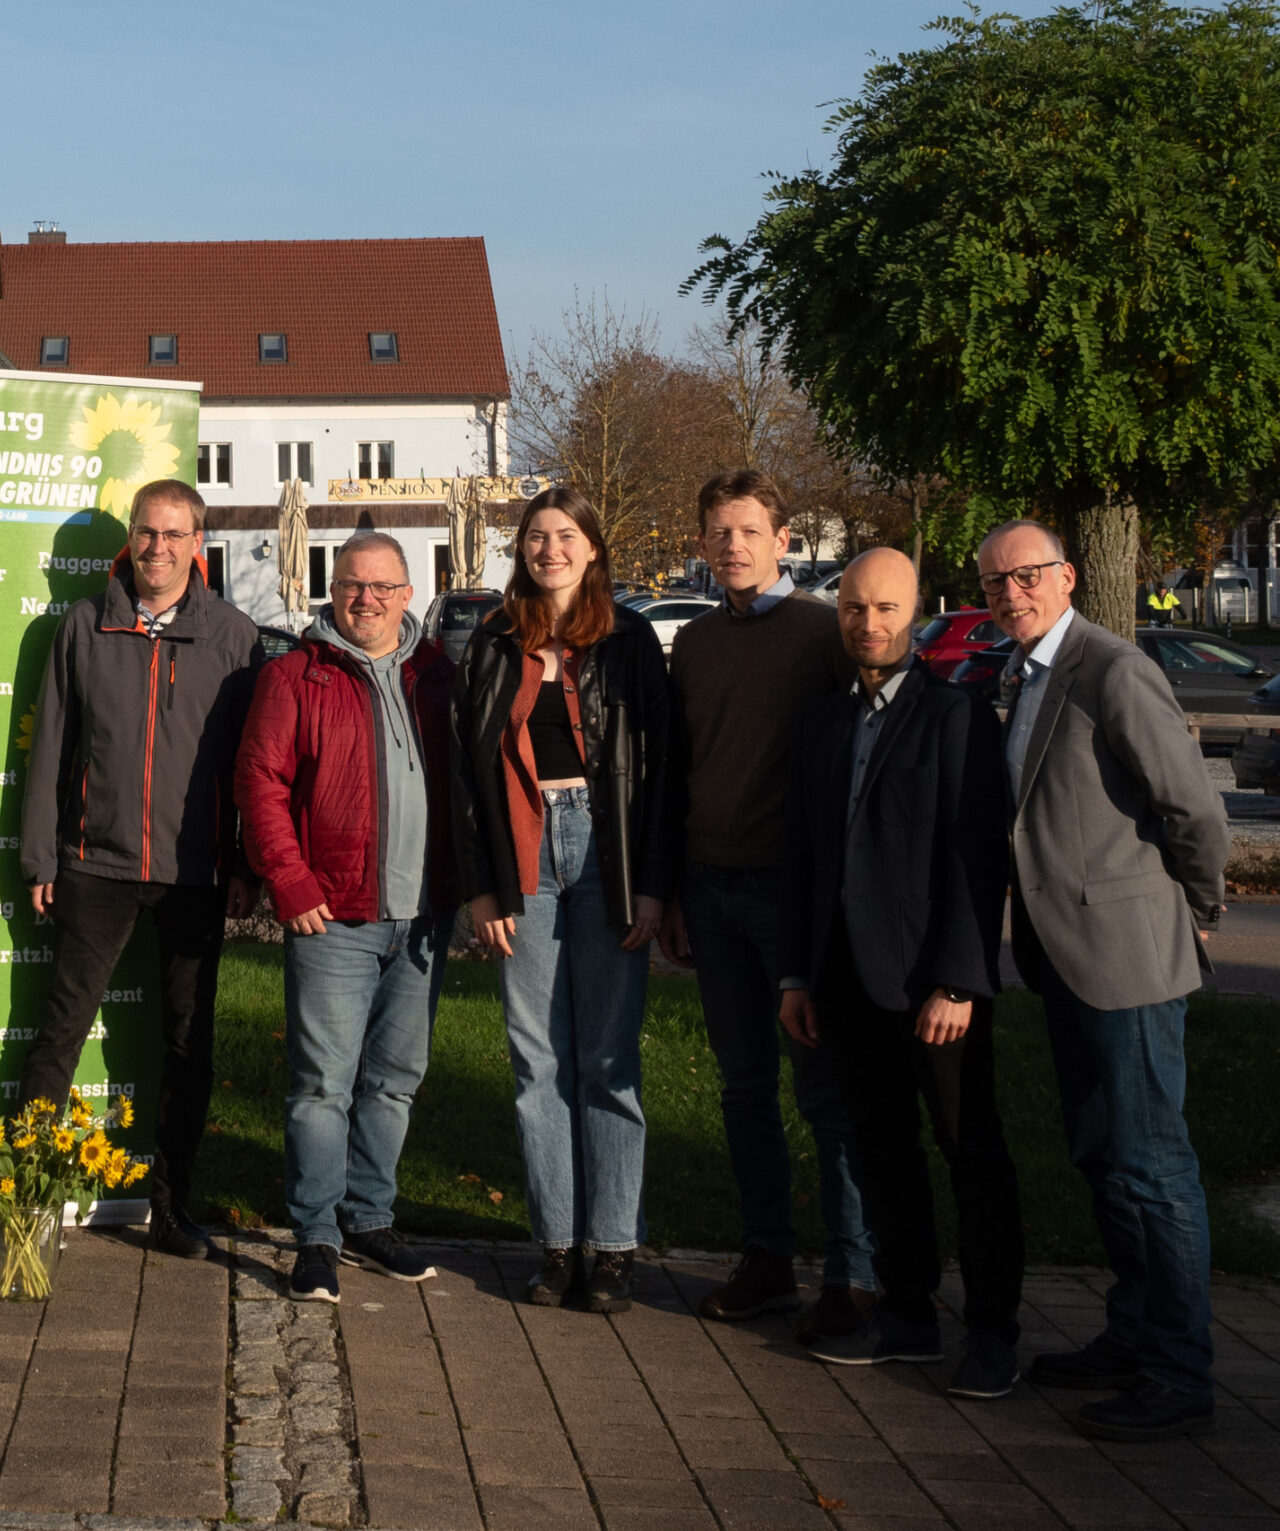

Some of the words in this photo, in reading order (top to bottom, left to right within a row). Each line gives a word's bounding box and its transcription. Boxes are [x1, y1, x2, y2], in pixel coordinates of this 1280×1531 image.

[70, 455, 102, 479] 90
[0, 477, 98, 508] GRÜNEN
[37, 551, 115, 575] Duggen
[20, 597, 70, 616] Neut
[101, 986, 144, 1002] sent
